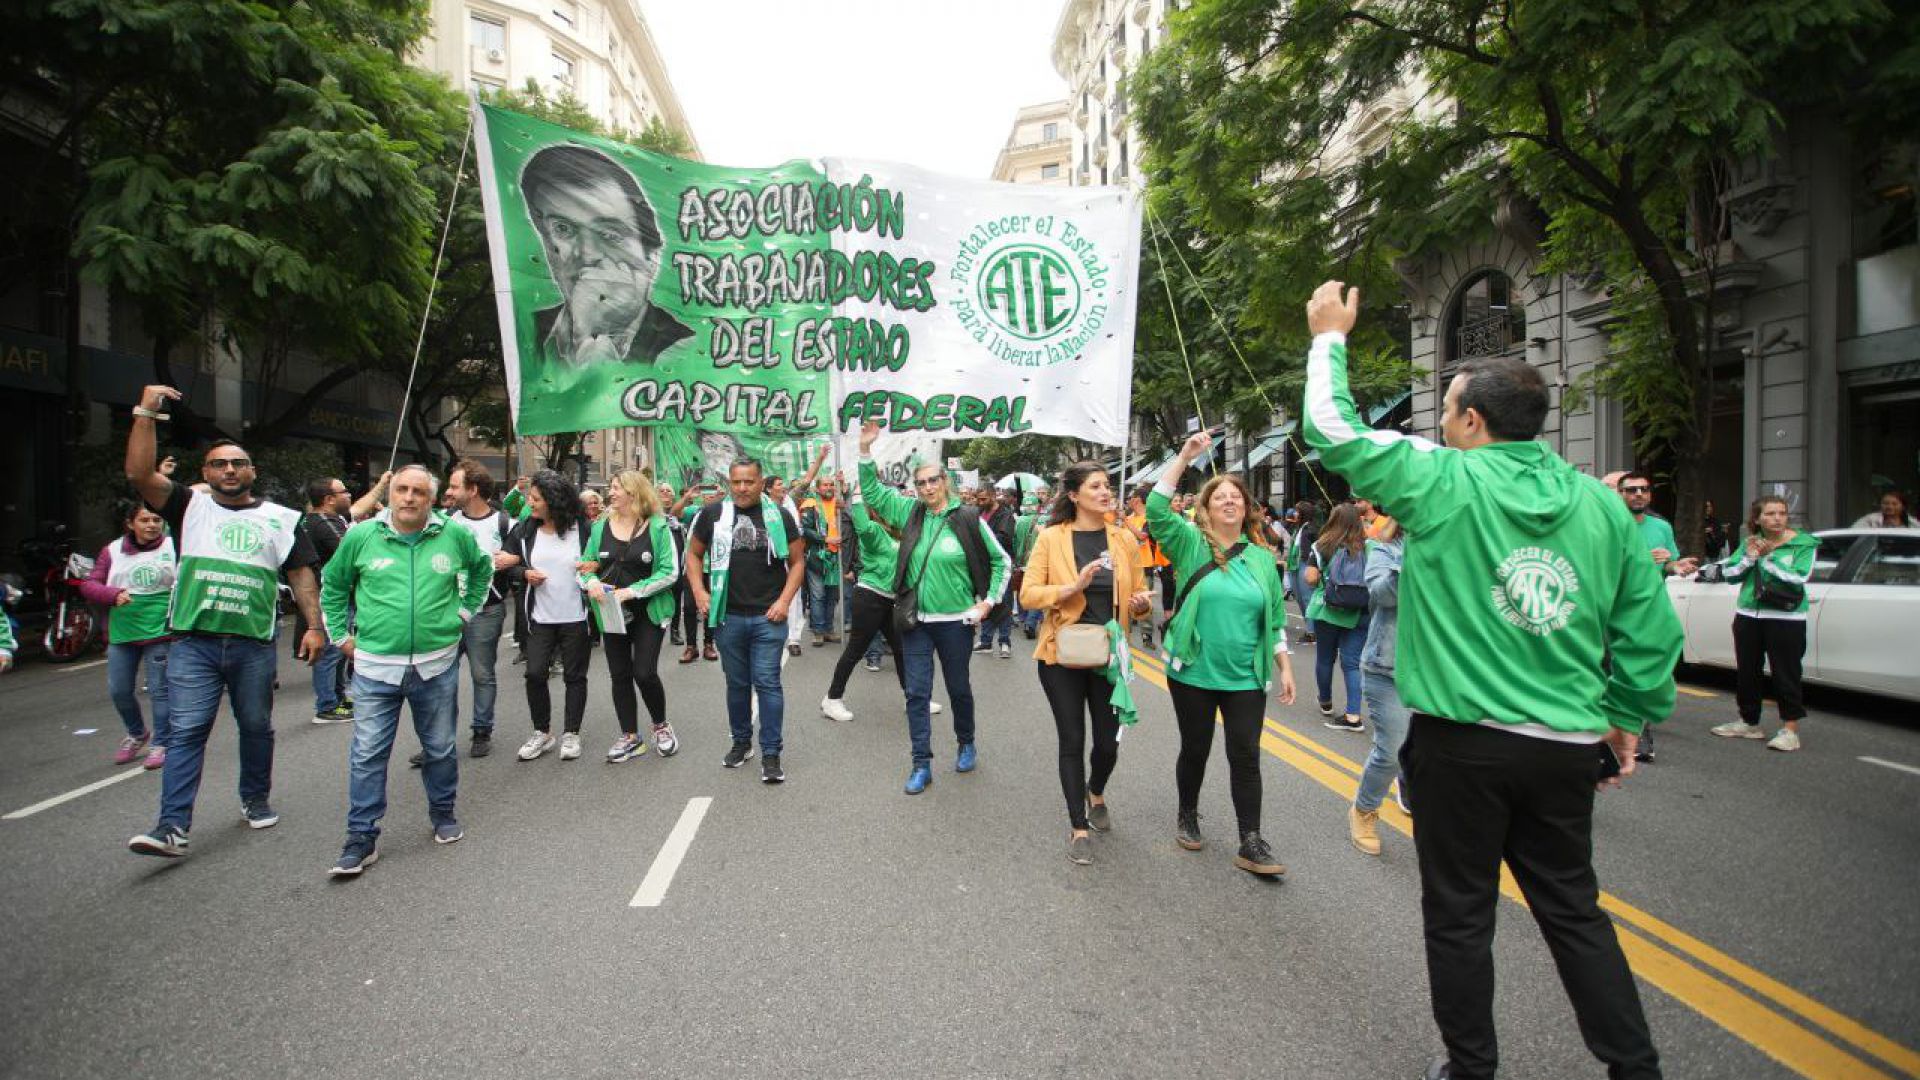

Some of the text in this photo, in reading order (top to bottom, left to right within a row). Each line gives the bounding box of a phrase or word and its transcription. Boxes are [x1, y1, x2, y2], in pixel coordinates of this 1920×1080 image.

[678, 174, 904, 241] ASOCIACIÓN
[672, 248, 937, 312] TRABAJADORES
[950, 215, 1109, 289] Fortalecer el Estado
[986, 251, 1071, 333] ATE
[710, 317, 910, 372] DEL ESTADO
[950, 299, 988, 342] para
[987, 333, 1042, 367] liberar
[621, 379, 1032, 433] CAPITAL FEDERAL
[1511, 569, 1559, 619] ATE
